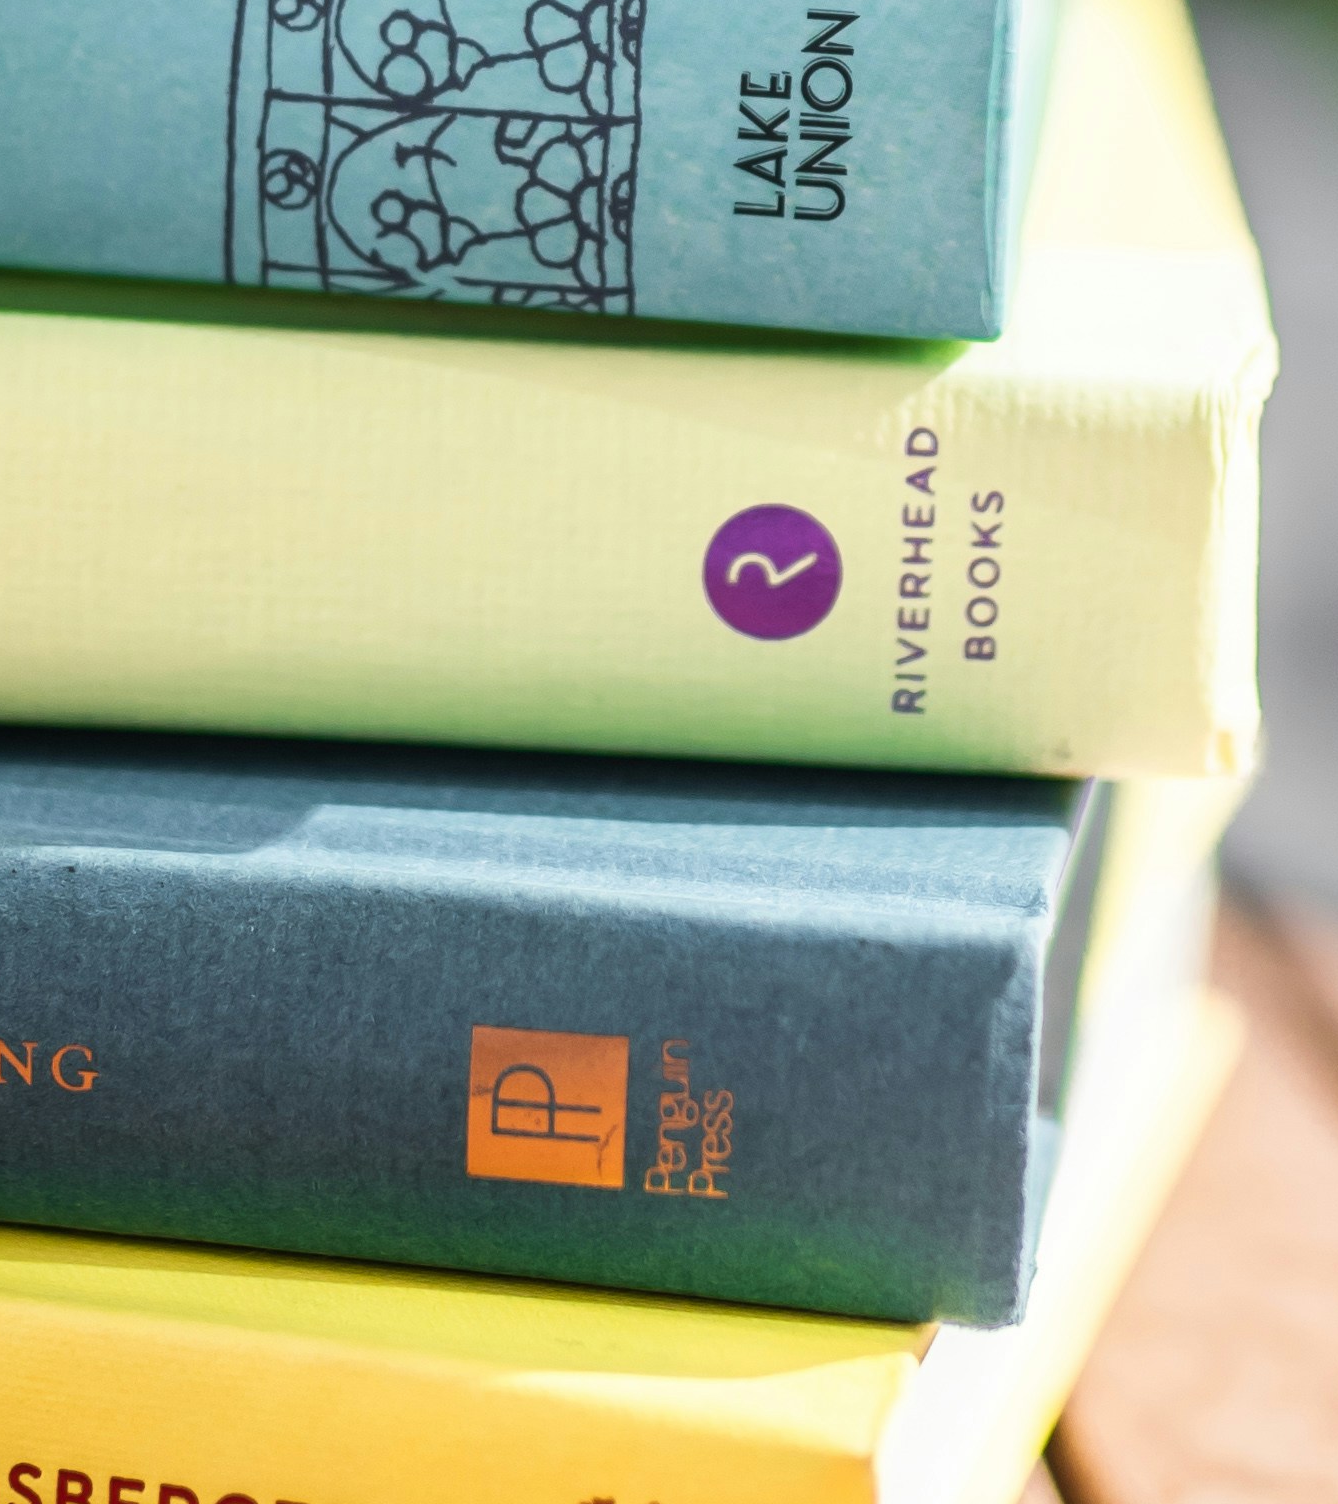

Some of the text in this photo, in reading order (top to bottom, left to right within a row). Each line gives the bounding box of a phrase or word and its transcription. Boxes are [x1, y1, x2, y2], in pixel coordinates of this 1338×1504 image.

[731, 70, 794, 220] LAKE
[791, 8, 861, 222] UNION
[890, 426, 940, 716] RIVERHEAD
[963, 490, 1005, 662] BOOKS
[643, 1038, 701, 1194] Penguin
[686, 1088, 735, 1200] Press
